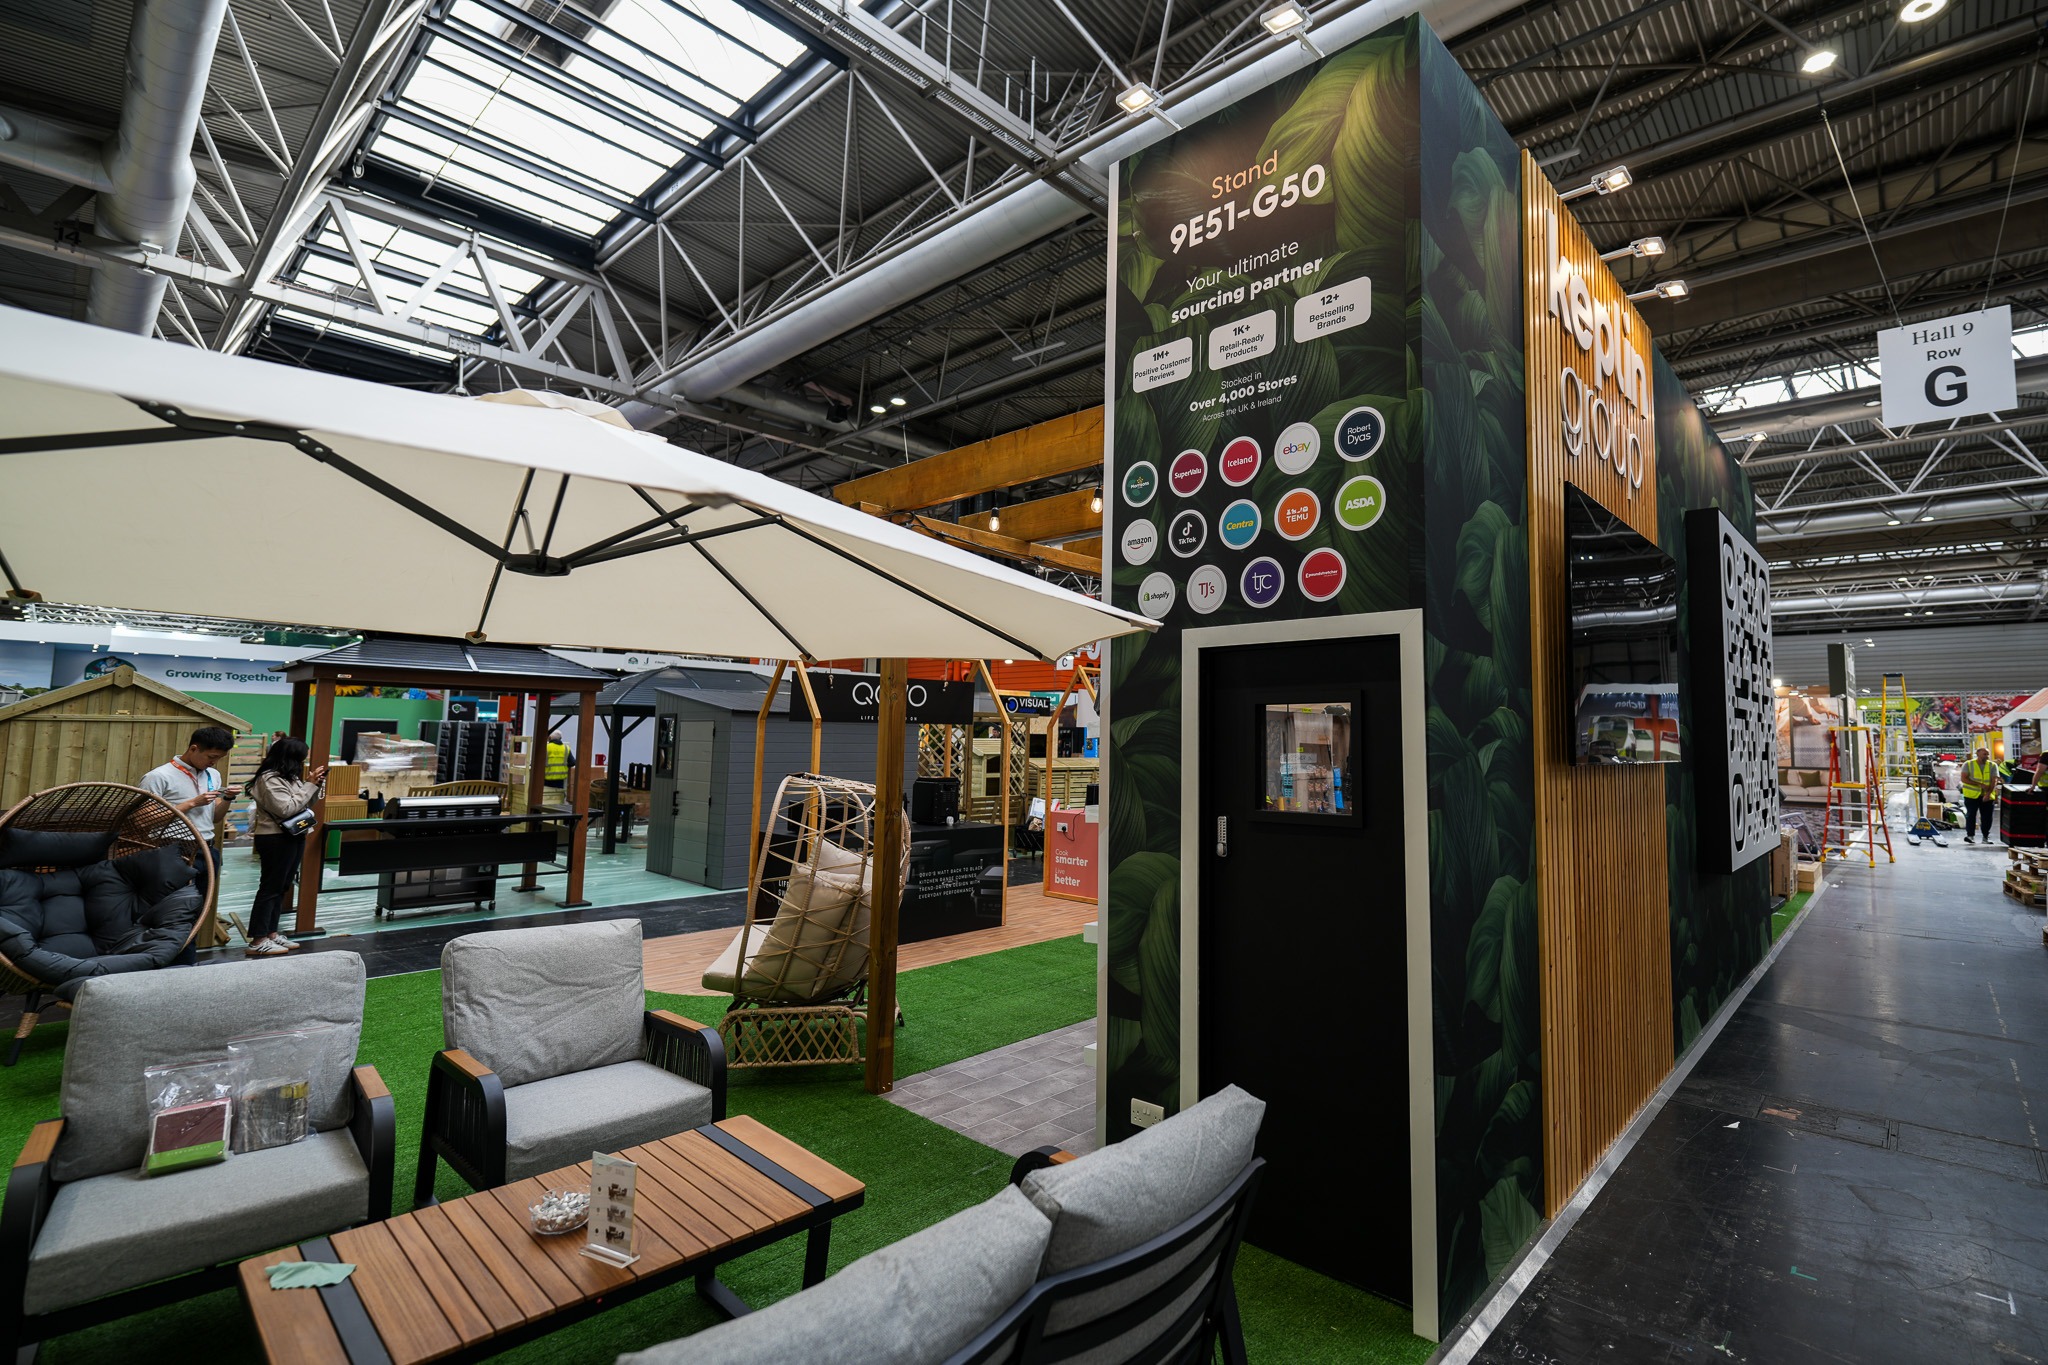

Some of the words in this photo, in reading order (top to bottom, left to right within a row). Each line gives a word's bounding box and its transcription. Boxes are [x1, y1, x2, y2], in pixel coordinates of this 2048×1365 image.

[1211, 150, 1278, 199] Stand
[1170, 164, 1326, 254] 9E51-G50
[1186, 268, 1222, 294] Your
[1228, 240, 1299, 279] ultimate
[1171, 284, 1245, 324] sourcing
[1250, 256, 1323, 300] partner
[1320, 293, 1340, 306] 12+
[1309, 303, 1355, 323] Bestselling
[1546, 208, 1647, 419] keplin
[1317, 315, 1347, 330] Brands
[1232, 324, 1251, 337] 1K+
[1912, 325, 1956, 346] Hall
[1962, 322, 1974, 336] 9
[1219, 333, 1265, 353] Retail-Ready
[1152, 350, 1170, 362] 1M+
[1225, 345, 1258, 360] Products
[1927, 347, 1962, 361] Row
[1134, 365, 1159, 379] Positive
[1160, 356, 1191, 371] Customer
[1149, 370, 1175, 383] Reviews
[1220, 372, 1253, 390] Stocked
[1254, 371, 1262, 380] in
[1189, 397, 1216, 412] Over
[1218, 385, 1255, 404] 4,000
[1257, 374, 1298, 393] Stores
[1924, 365, 1969, 408] G
[1202, 411, 1225, 422] Across
[1226, 407, 1237, 416] the
[1238, 403, 1249, 413] UK
[1250, 401, 1256, 410] &
[1257, 394, 1282, 408] Ireland
[1347, 423, 1371, 435] Robert
[1561, 366, 1643, 500] group
[1347, 432, 1372, 445] Dyas
[1283, 441, 1311, 455] ebay
[1227, 455, 1253, 468] Iceland
[1174, 467, 1202, 479] SuperValu
[1345, 496, 1375, 511] ASDA
[1286, 512, 1309, 523] TEMU
[1226, 520, 1254, 531] Centra
[1127, 536, 1152, 547] amazon
[1178, 537, 1197, 545] TikTok
[1150, 591, 1170, 601] shopify
[1198, 581, 1215, 599] TJ's
[165, 669, 222, 682] Growing
[225, 672, 282, 683] Together
[852, 681, 928, 707] QO
[1019, 698, 1049, 709] VISUAL
[1055, 848, 1069, 856] Cook
[1055, 855, 1088, 867] smarter
[1055, 867, 1066, 875] Live
[1054, 873, 1081, 887] better
